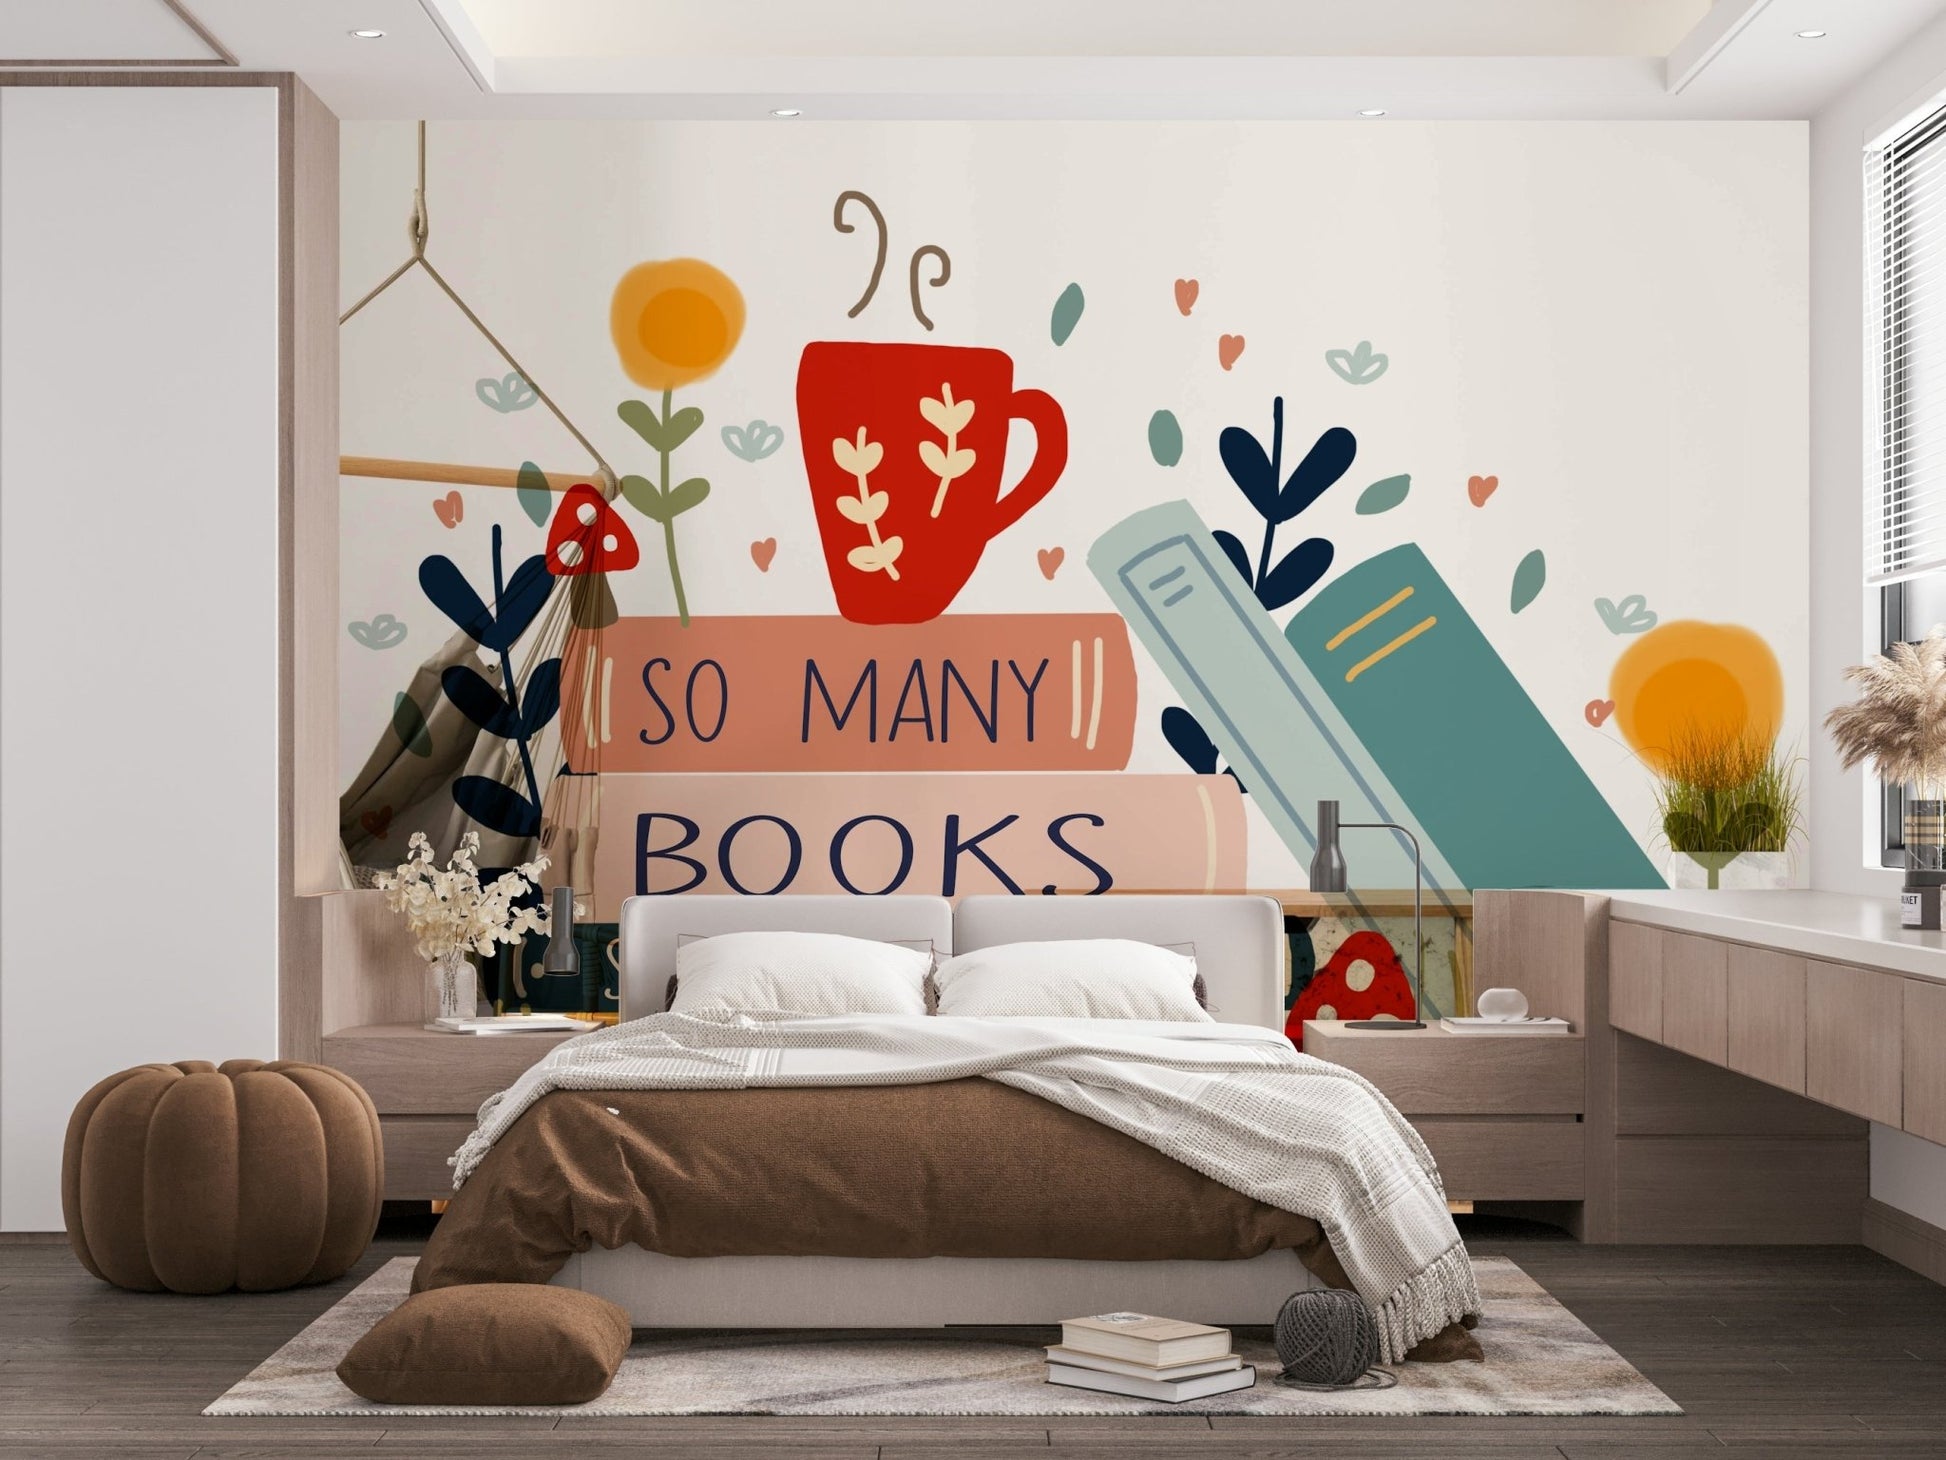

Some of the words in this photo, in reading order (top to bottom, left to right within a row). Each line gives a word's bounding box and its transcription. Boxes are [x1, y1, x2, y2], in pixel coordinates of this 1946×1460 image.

[639, 657, 728, 746] SO
[801, 658, 1049, 744] MANY
[635, 812, 1114, 897] BOOKS
